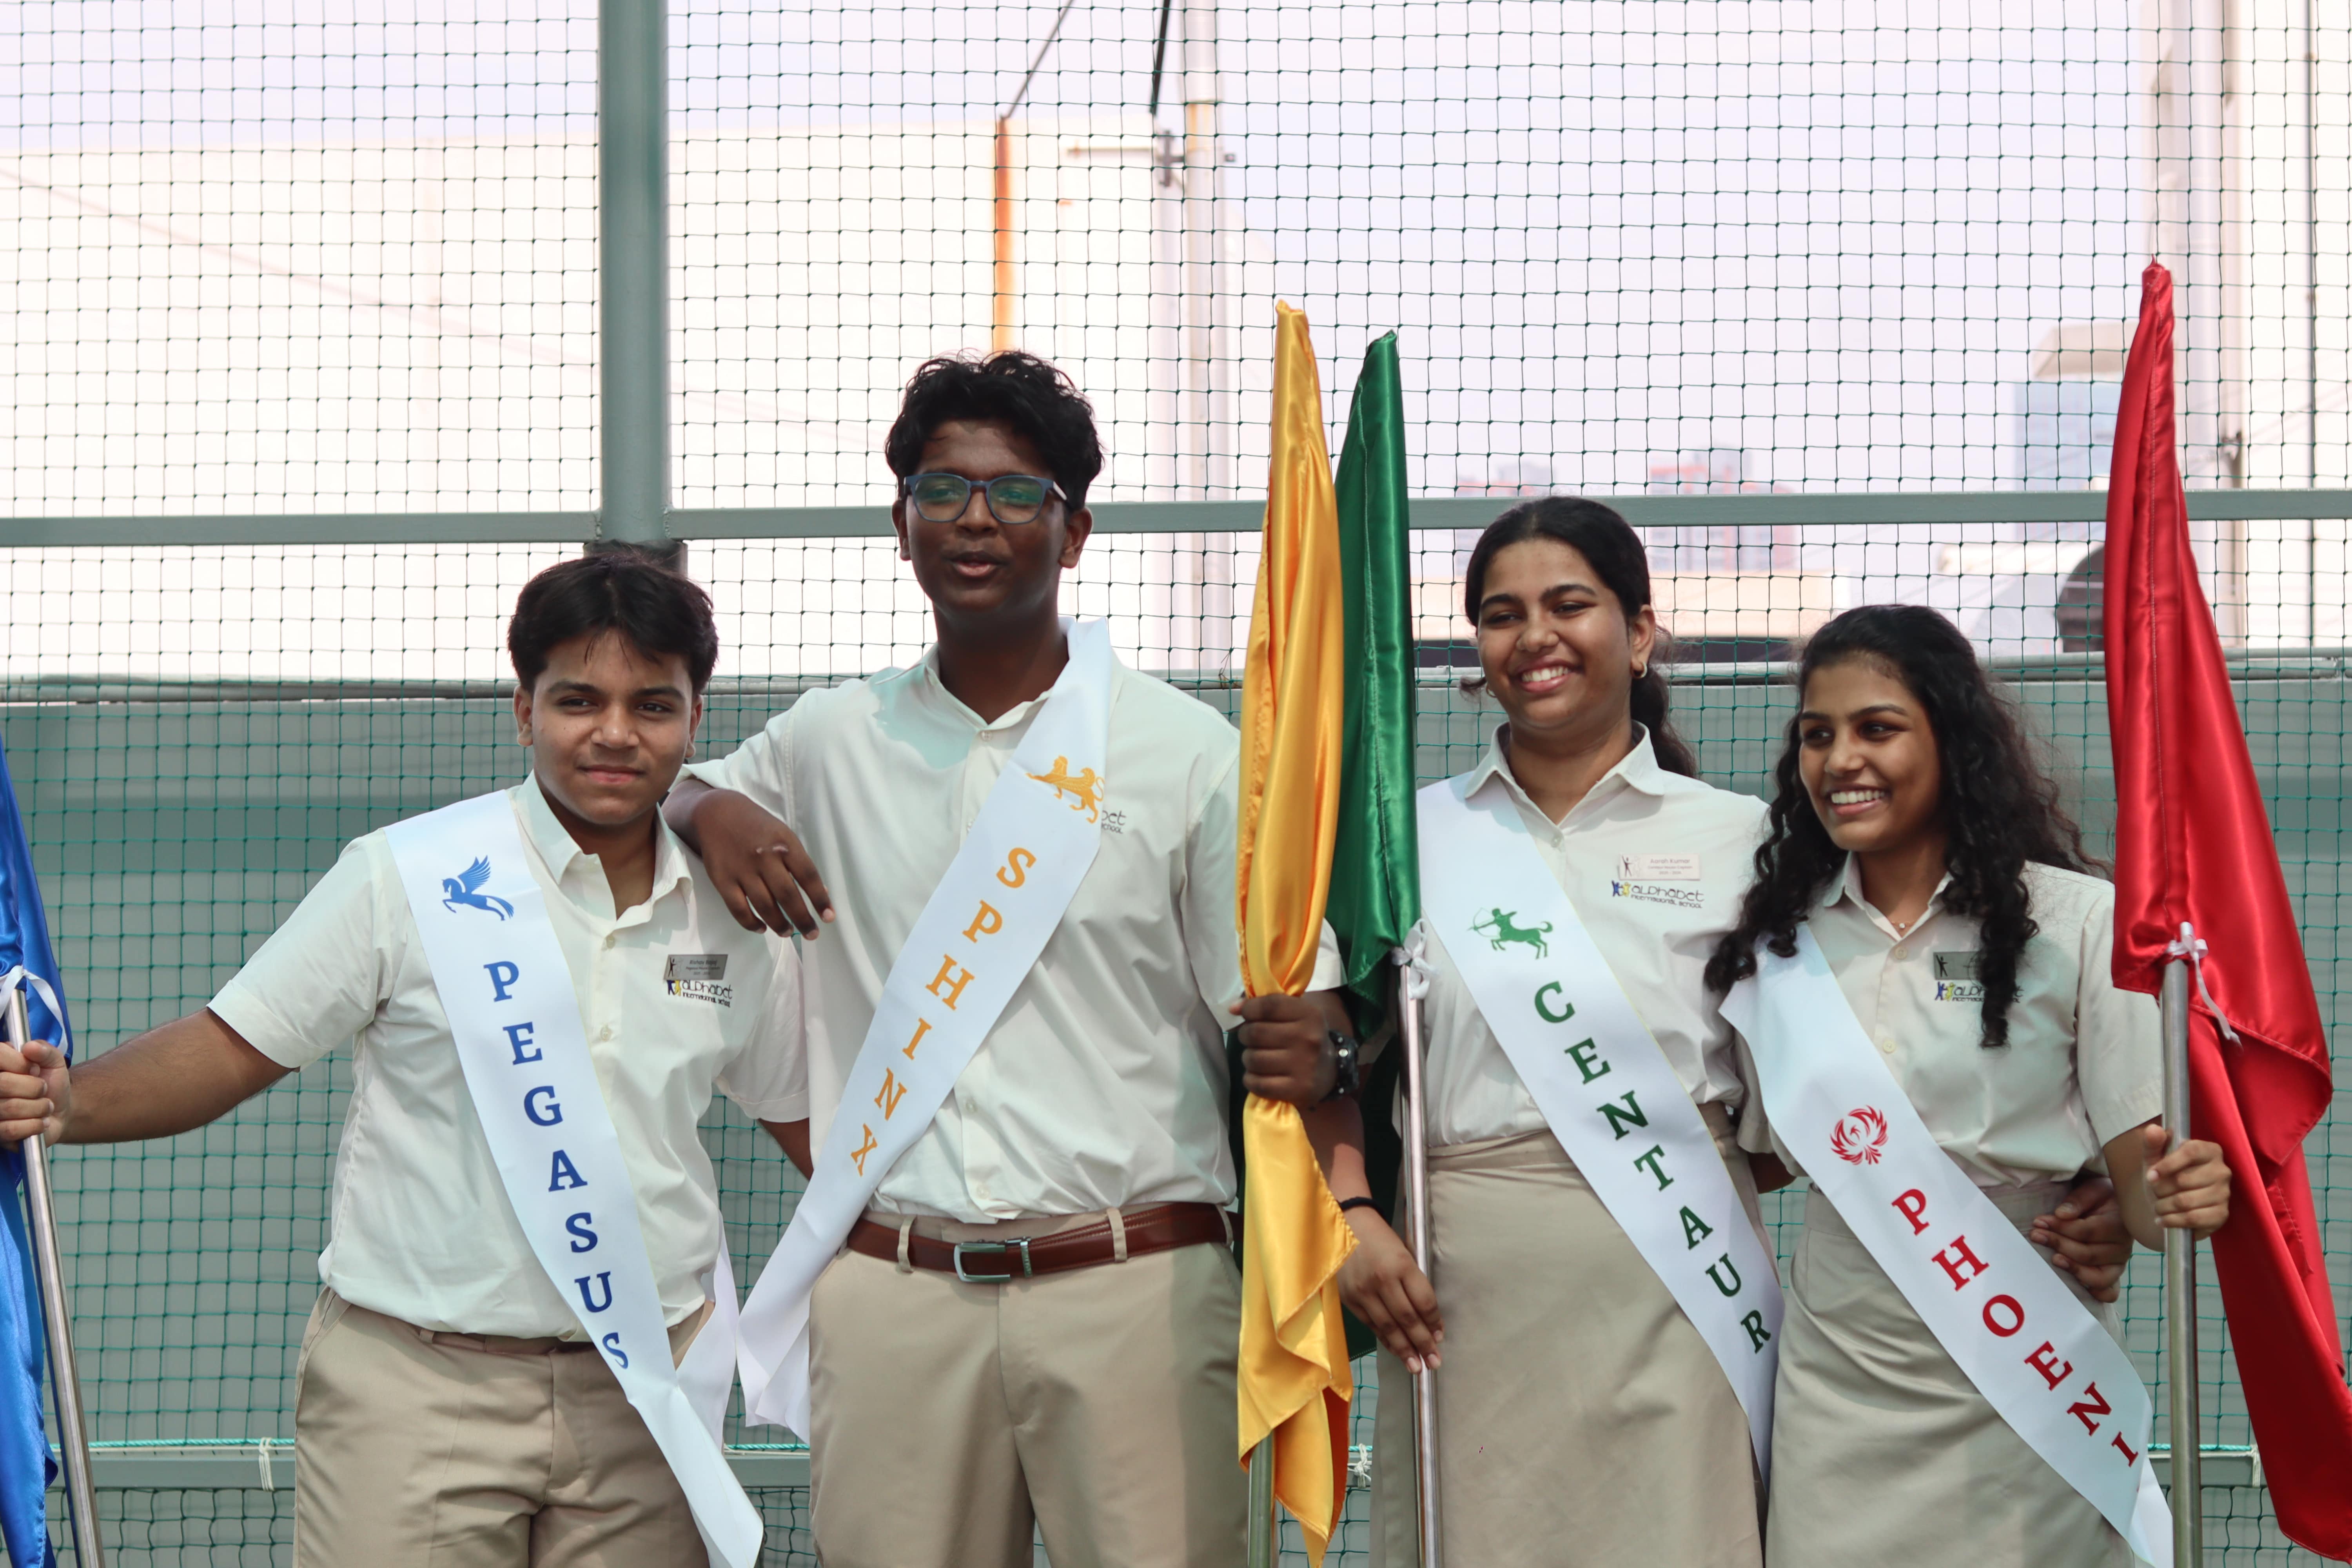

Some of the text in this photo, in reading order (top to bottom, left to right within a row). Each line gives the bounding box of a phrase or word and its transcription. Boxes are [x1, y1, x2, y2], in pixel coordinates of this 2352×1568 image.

[483, 960, 628, 1369] PEGASUS
[850, 847, 1037, 1177] SPHINX
[1534, 980, 1771, 1354] CENTAUR
[1891, 1189, 2139, 1493] PHOENI
